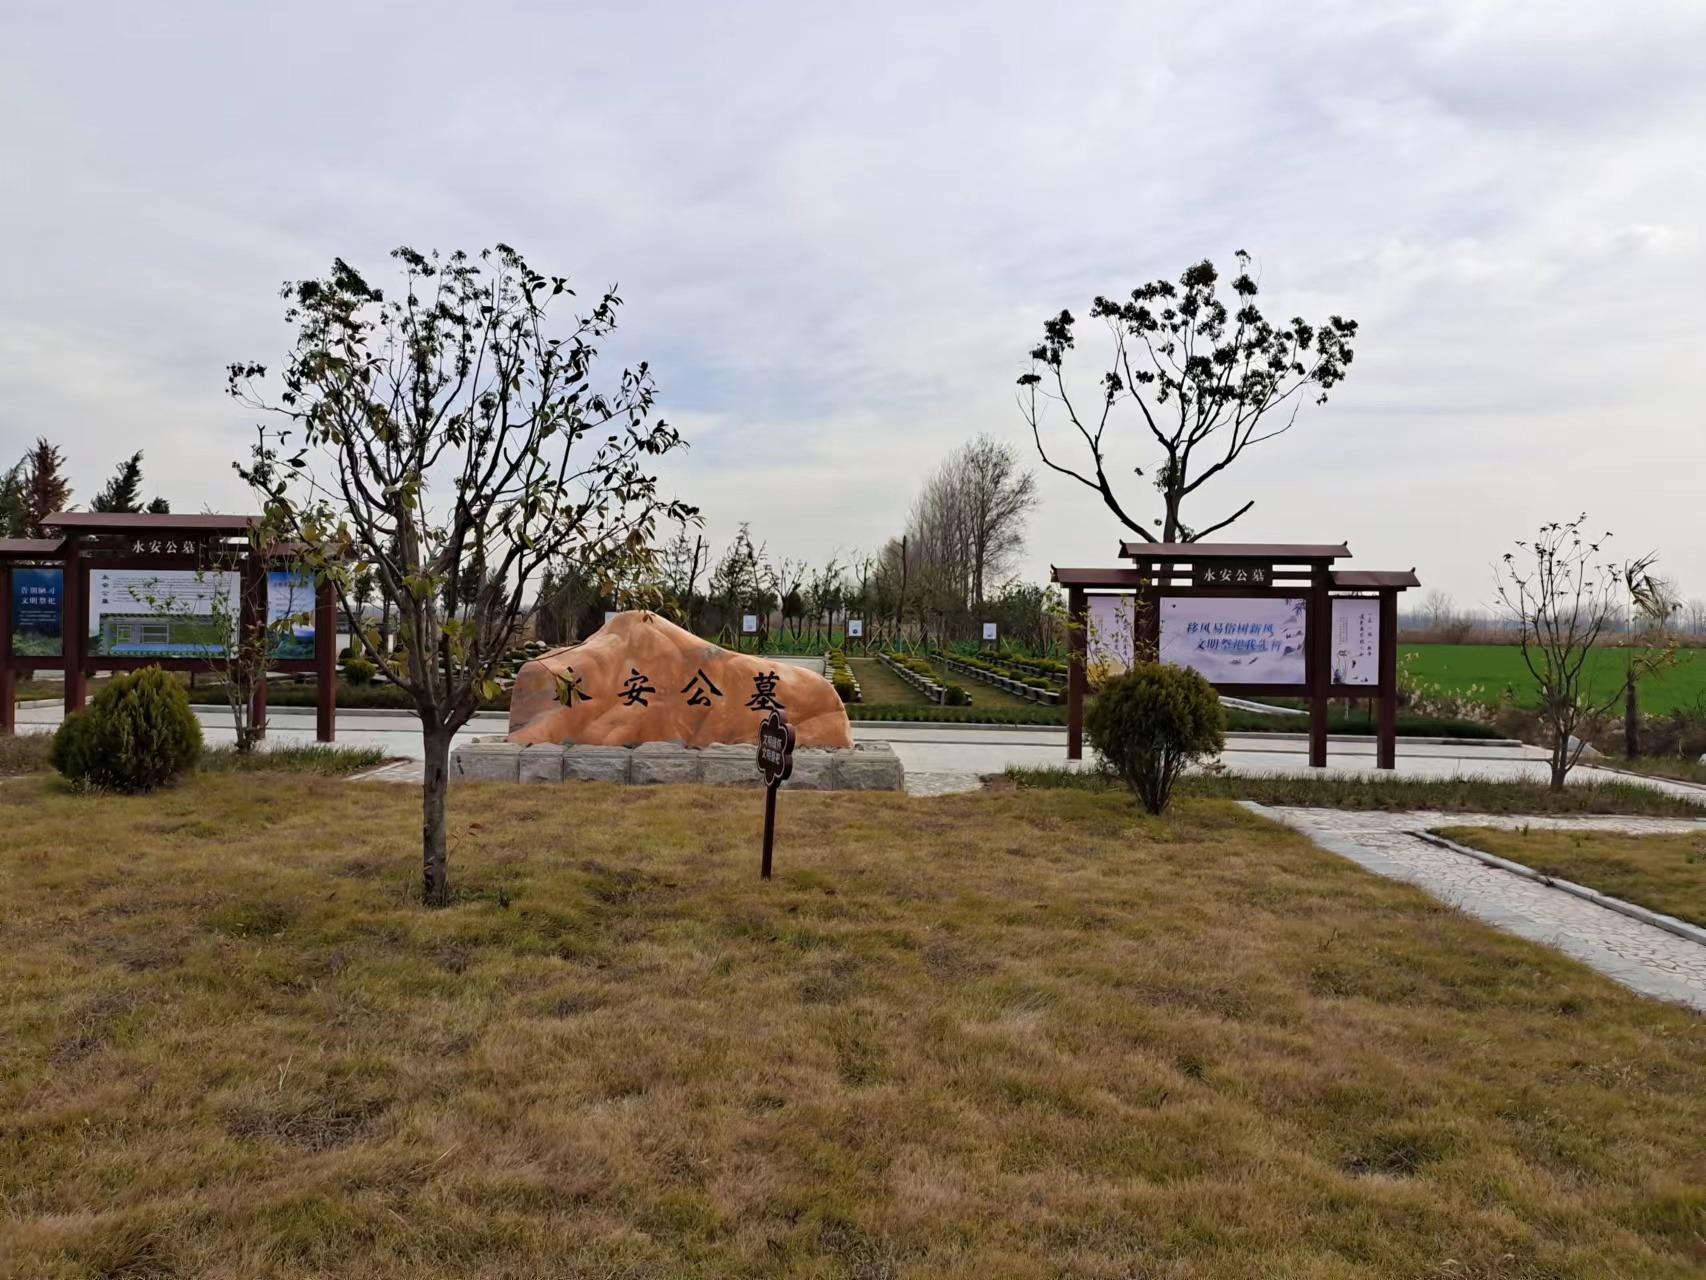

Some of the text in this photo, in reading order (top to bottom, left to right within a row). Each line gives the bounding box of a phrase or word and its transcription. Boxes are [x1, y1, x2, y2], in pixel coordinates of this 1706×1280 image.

[133, 540, 195, 554] 永安公墓
[1203, 568, 1265, 582] 永安公墓
[553, 666, 786, 712] 永安公墓
